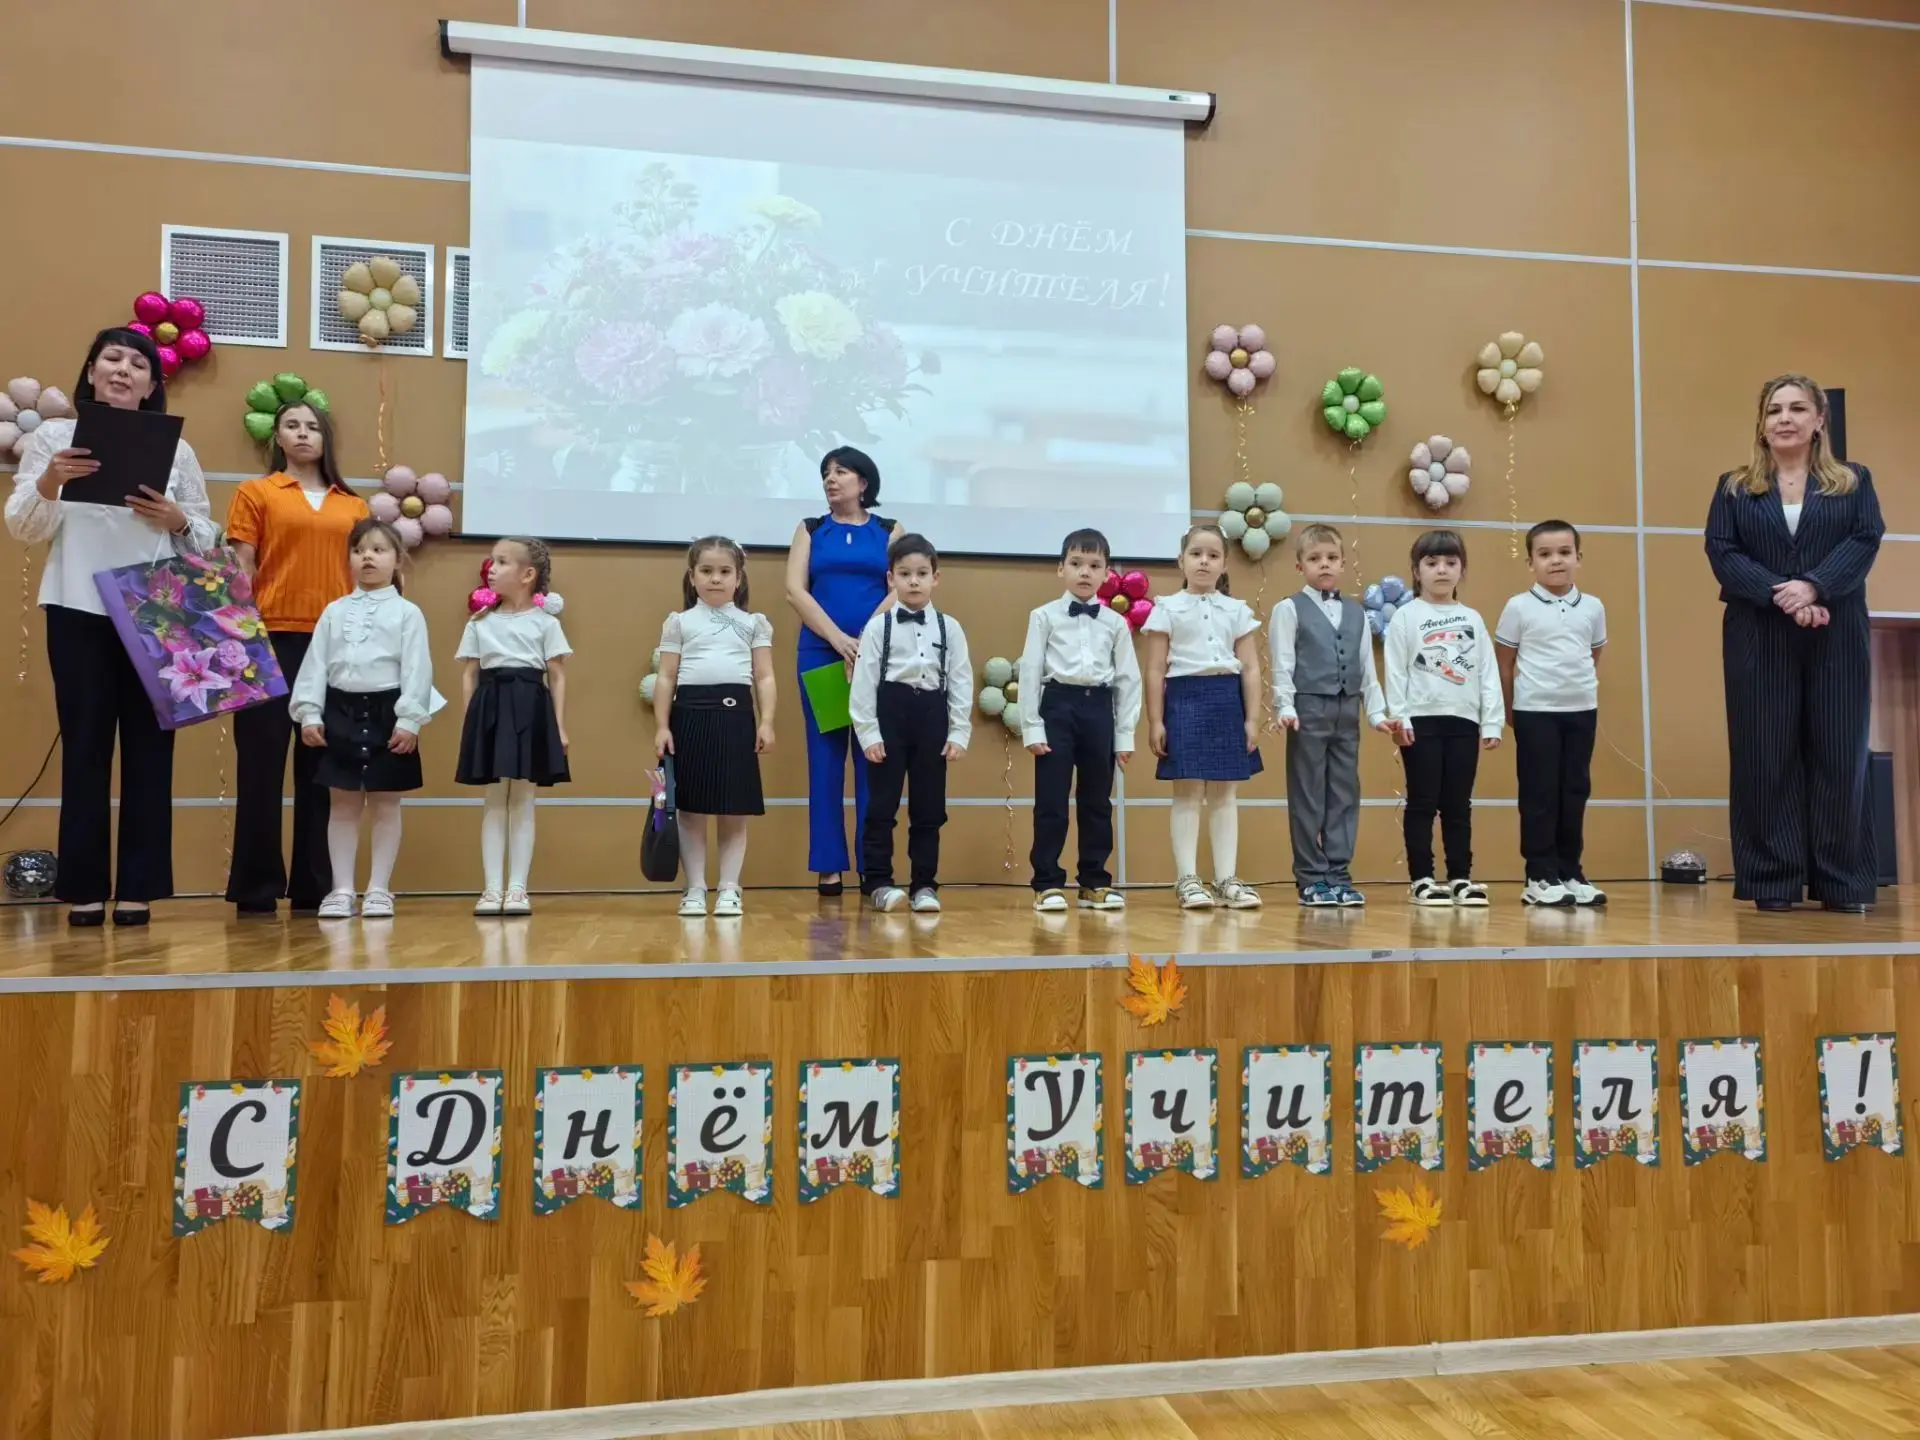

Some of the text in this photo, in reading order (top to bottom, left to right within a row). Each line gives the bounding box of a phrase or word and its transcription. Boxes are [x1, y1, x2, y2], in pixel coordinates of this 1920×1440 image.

[945, 217, 1133, 256] С ДНЁМ
[1420, 616, 1467, 630] Awesome
[1452, 655, 1474, 671] Girl
[209, 1099, 267, 1178] С
[406, 1086, 889, 1167] Днём
